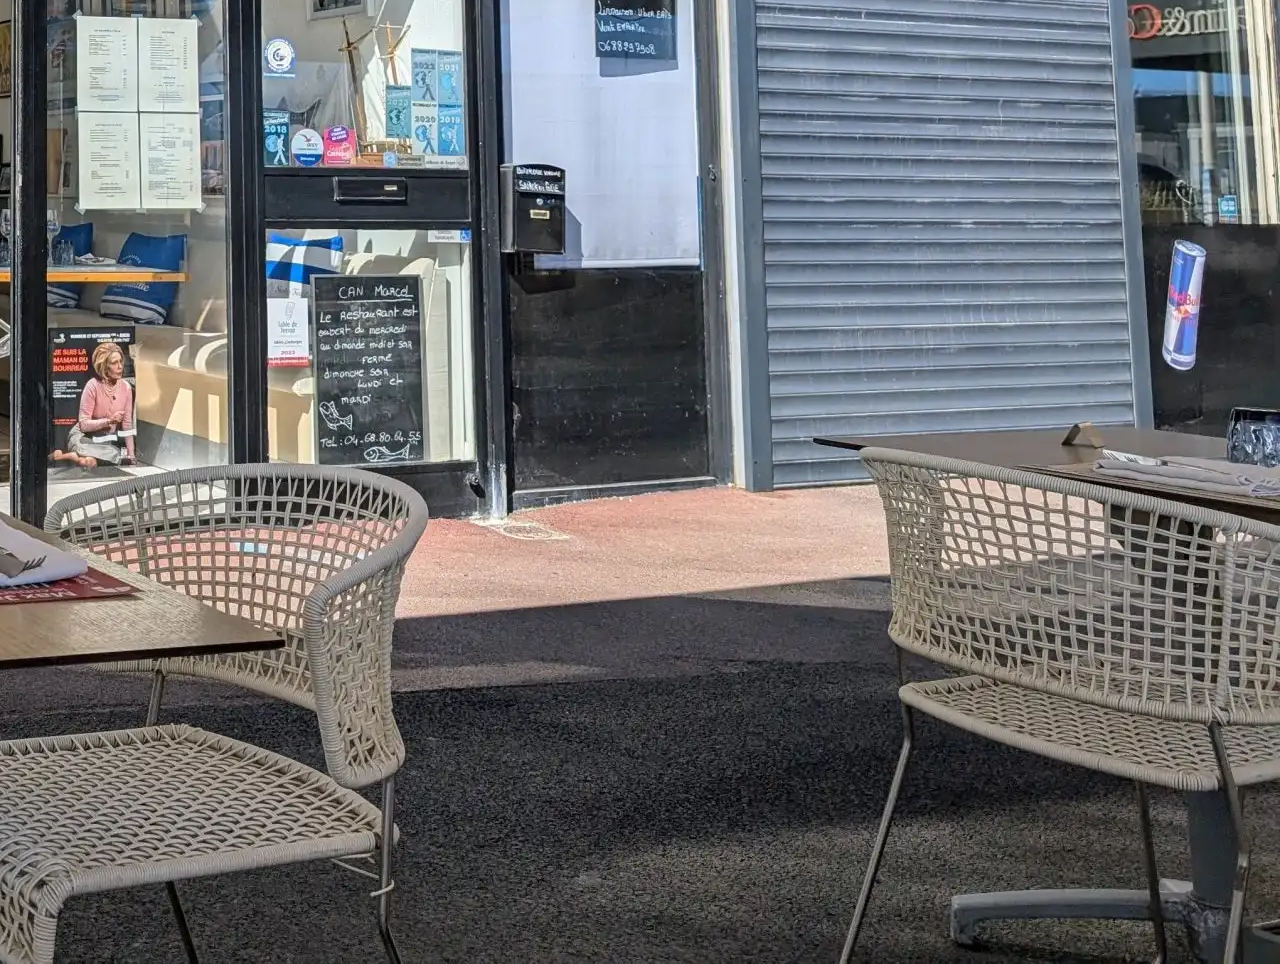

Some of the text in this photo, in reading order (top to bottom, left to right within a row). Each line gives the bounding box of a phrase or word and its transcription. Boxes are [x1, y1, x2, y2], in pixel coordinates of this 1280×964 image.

[265, 125, 287, 134] 2018
[338, 285, 364, 299] CAN
[320, 311, 331, 323] Le
